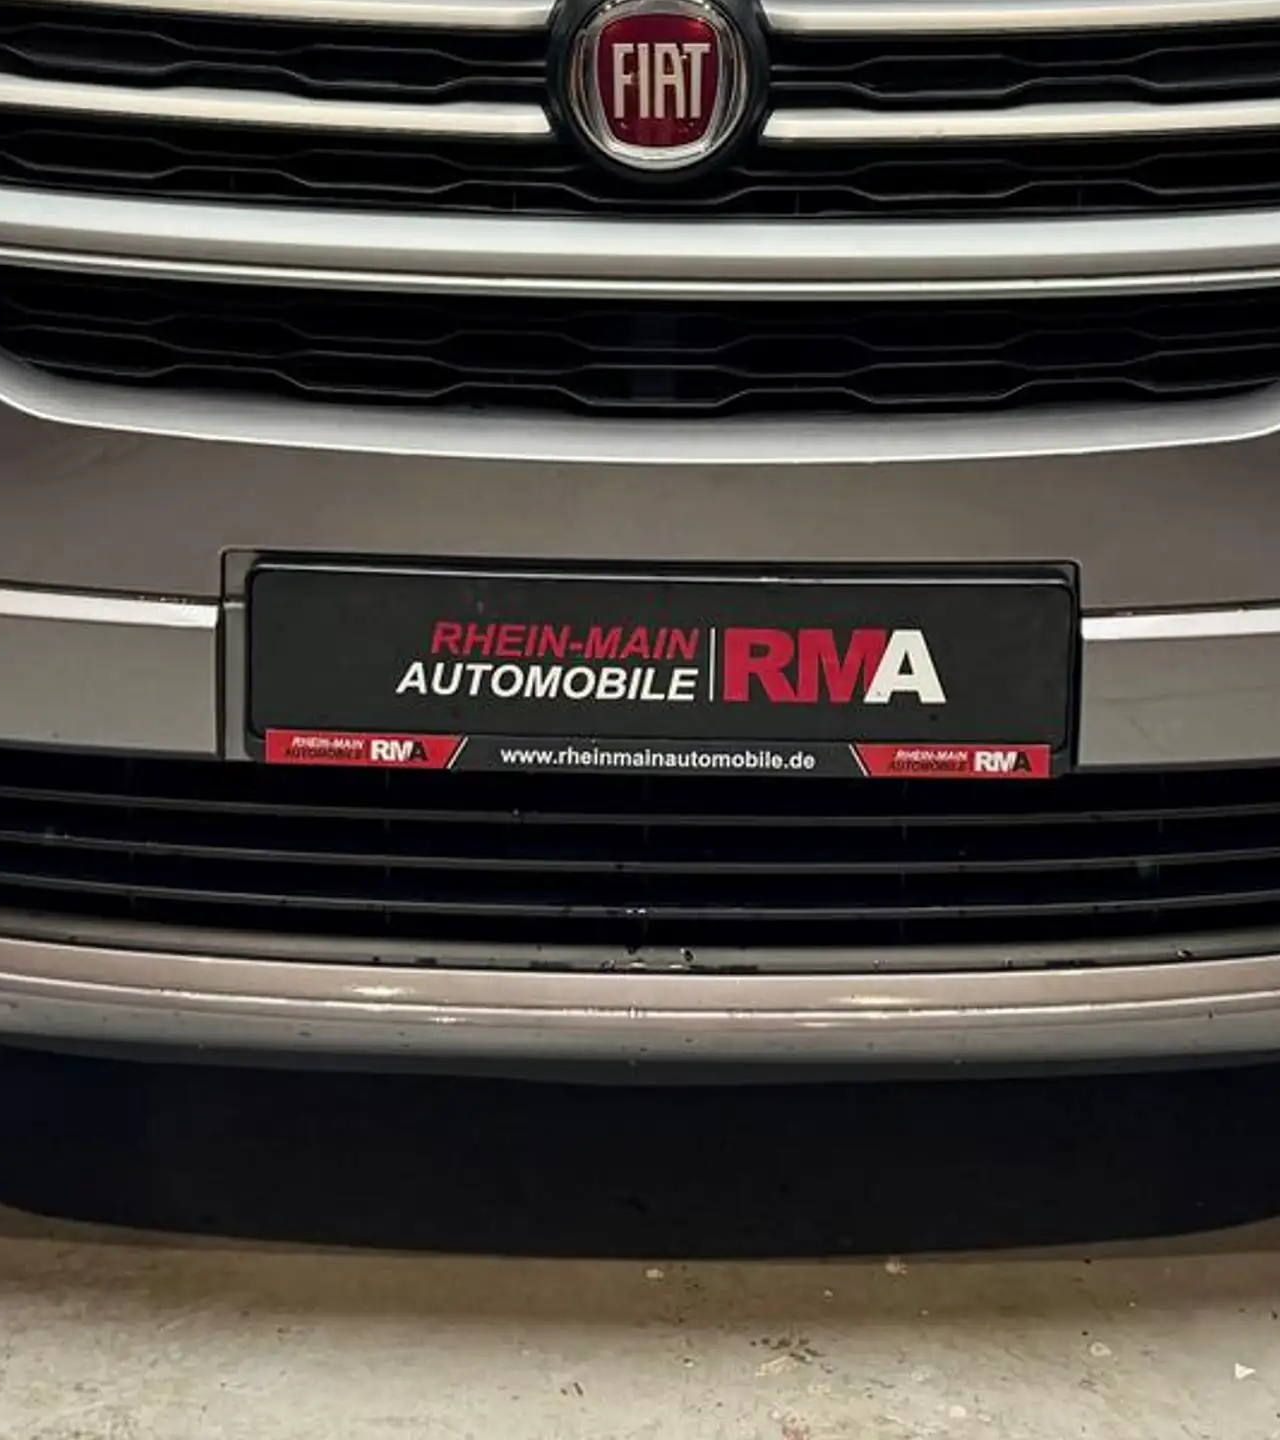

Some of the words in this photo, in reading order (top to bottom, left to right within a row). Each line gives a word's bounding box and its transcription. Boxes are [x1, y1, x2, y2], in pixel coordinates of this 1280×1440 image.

[612, 43, 710, 119] FIAT
[431, 621, 699, 659] RHEIN-MAIN
[396, 662, 699, 701] AUTOMOBILE
[723, 628, 947, 704] RMA
[370, 739, 429, 762] RMA
[500, 747, 816, 770] www.rheinmainautomobile.de
[974, 750, 1033, 772] RMA
